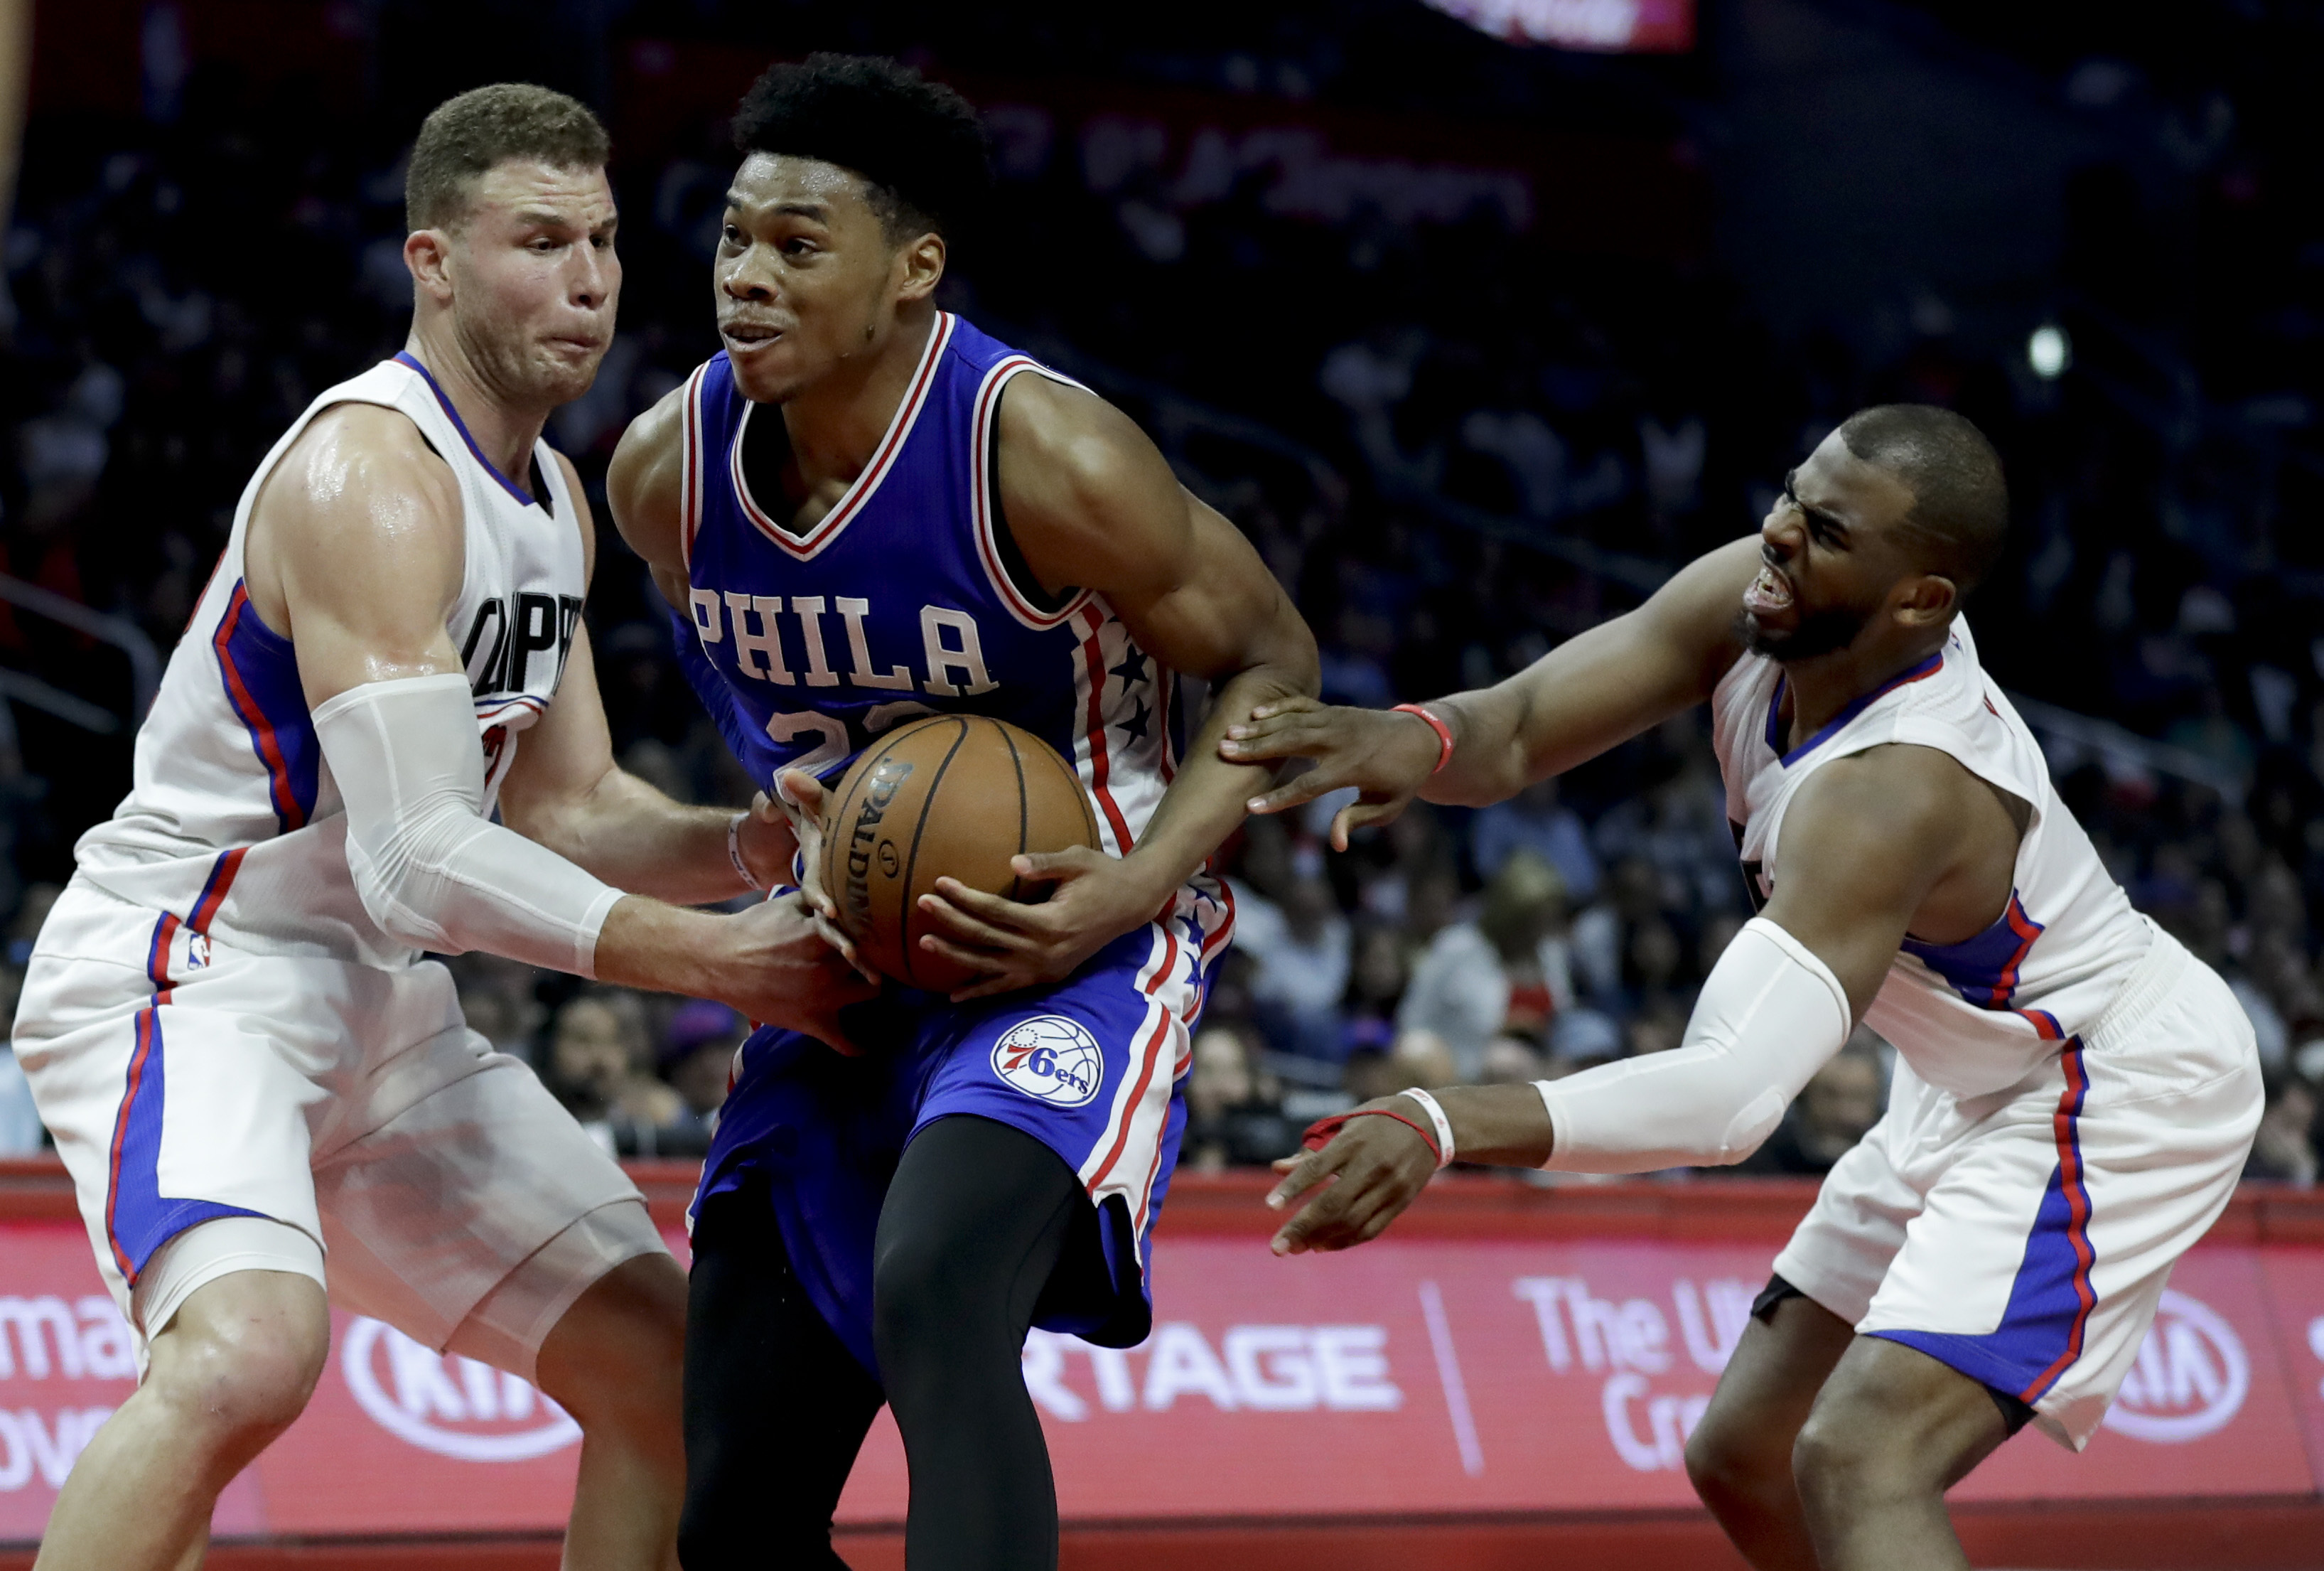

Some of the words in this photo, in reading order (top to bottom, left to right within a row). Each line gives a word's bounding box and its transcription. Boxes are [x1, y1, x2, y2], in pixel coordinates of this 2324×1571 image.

[689, 586, 1001, 697] PHILA
[765, 699, 945, 808] 2
[844, 757, 914, 927] SPALDIN
[1002, 1043, 1090, 1095] 76ers
[1512, 1275, 1675, 1378] The
